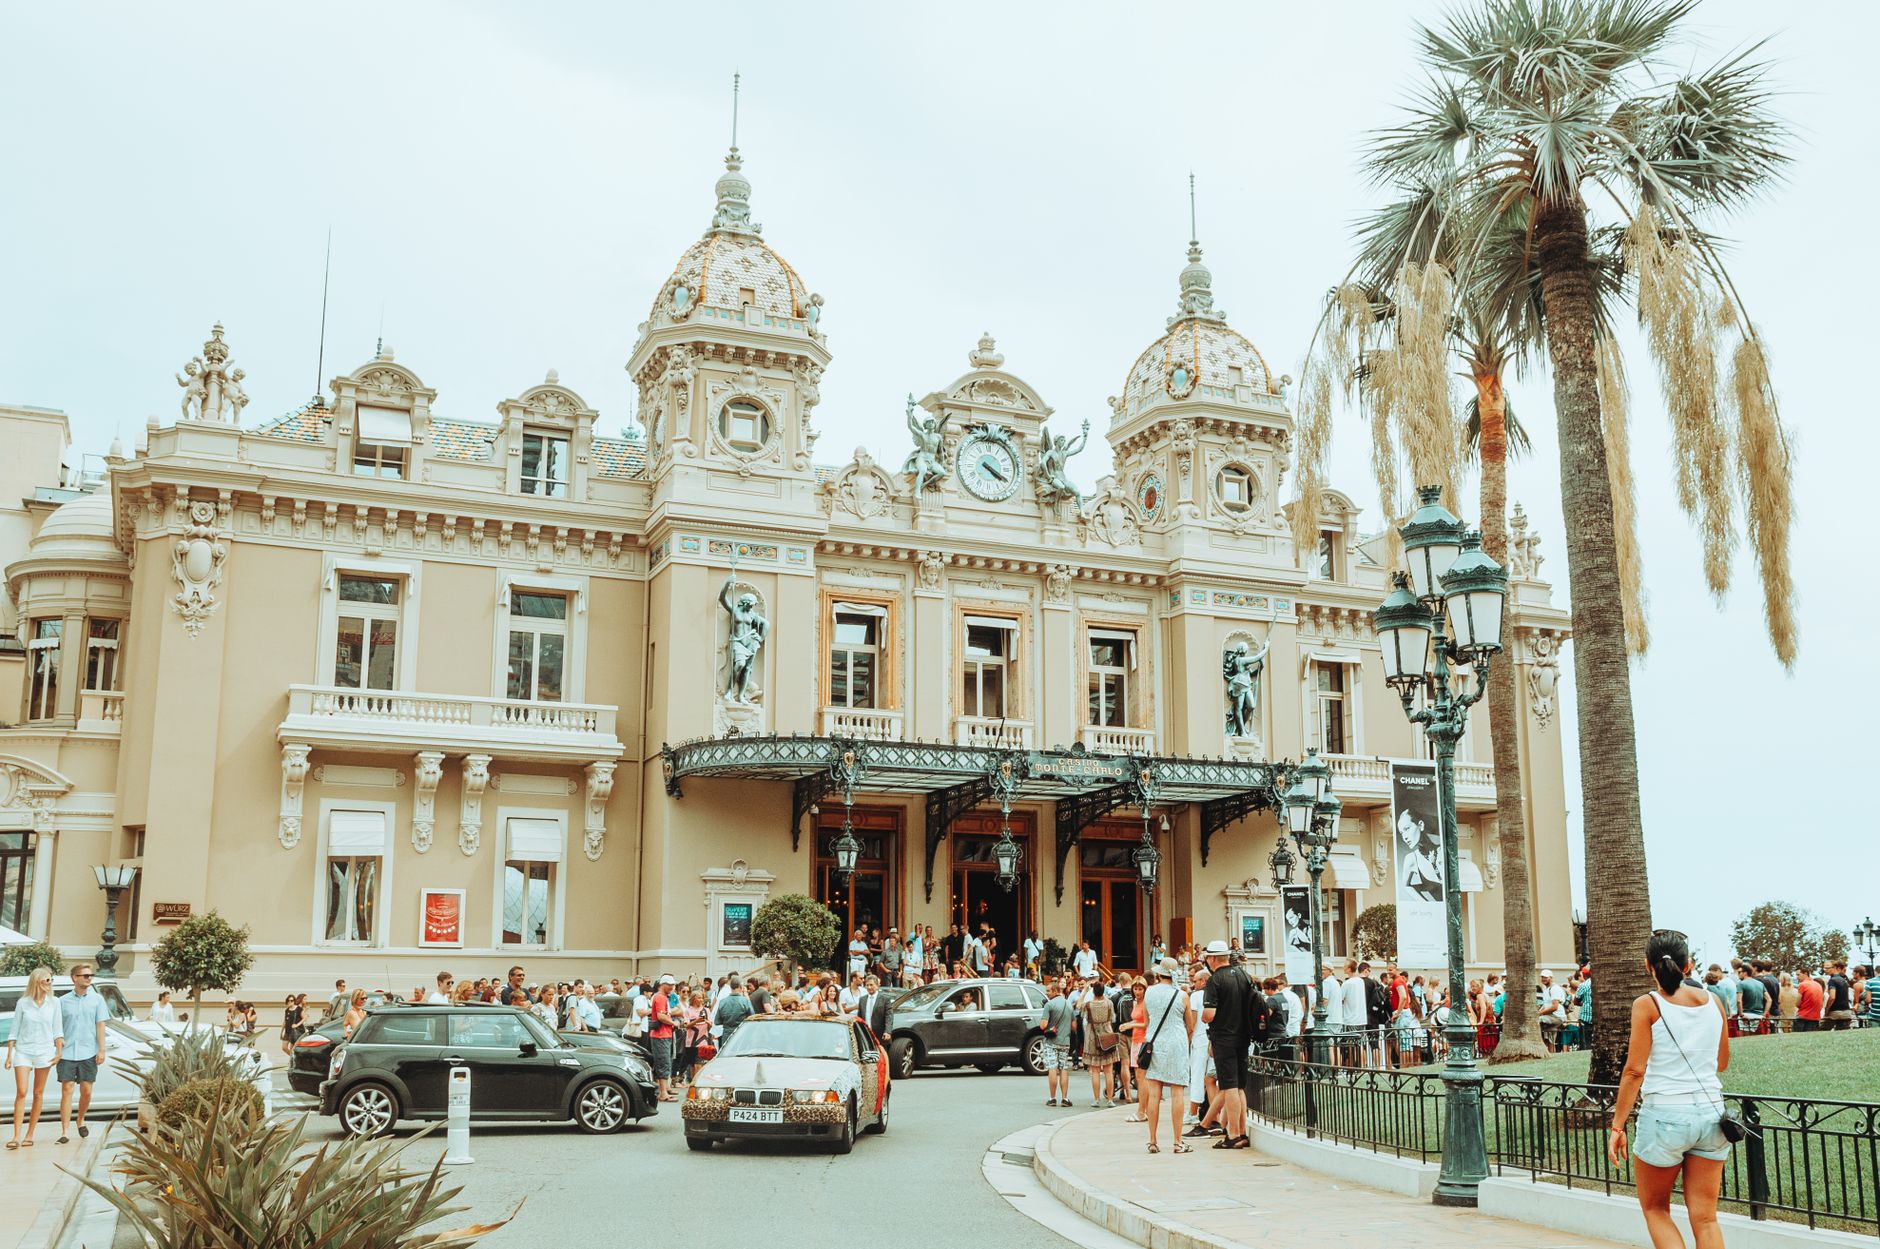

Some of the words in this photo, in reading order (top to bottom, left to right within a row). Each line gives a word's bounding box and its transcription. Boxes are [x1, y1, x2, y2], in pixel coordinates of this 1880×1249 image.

[1058, 758, 1099, 767] CASINO
[1399, 776, 1430, 786] CHANEL
[733, 1110, 758, 1121] P424
[760, 1111, 779, 1121] BTT
